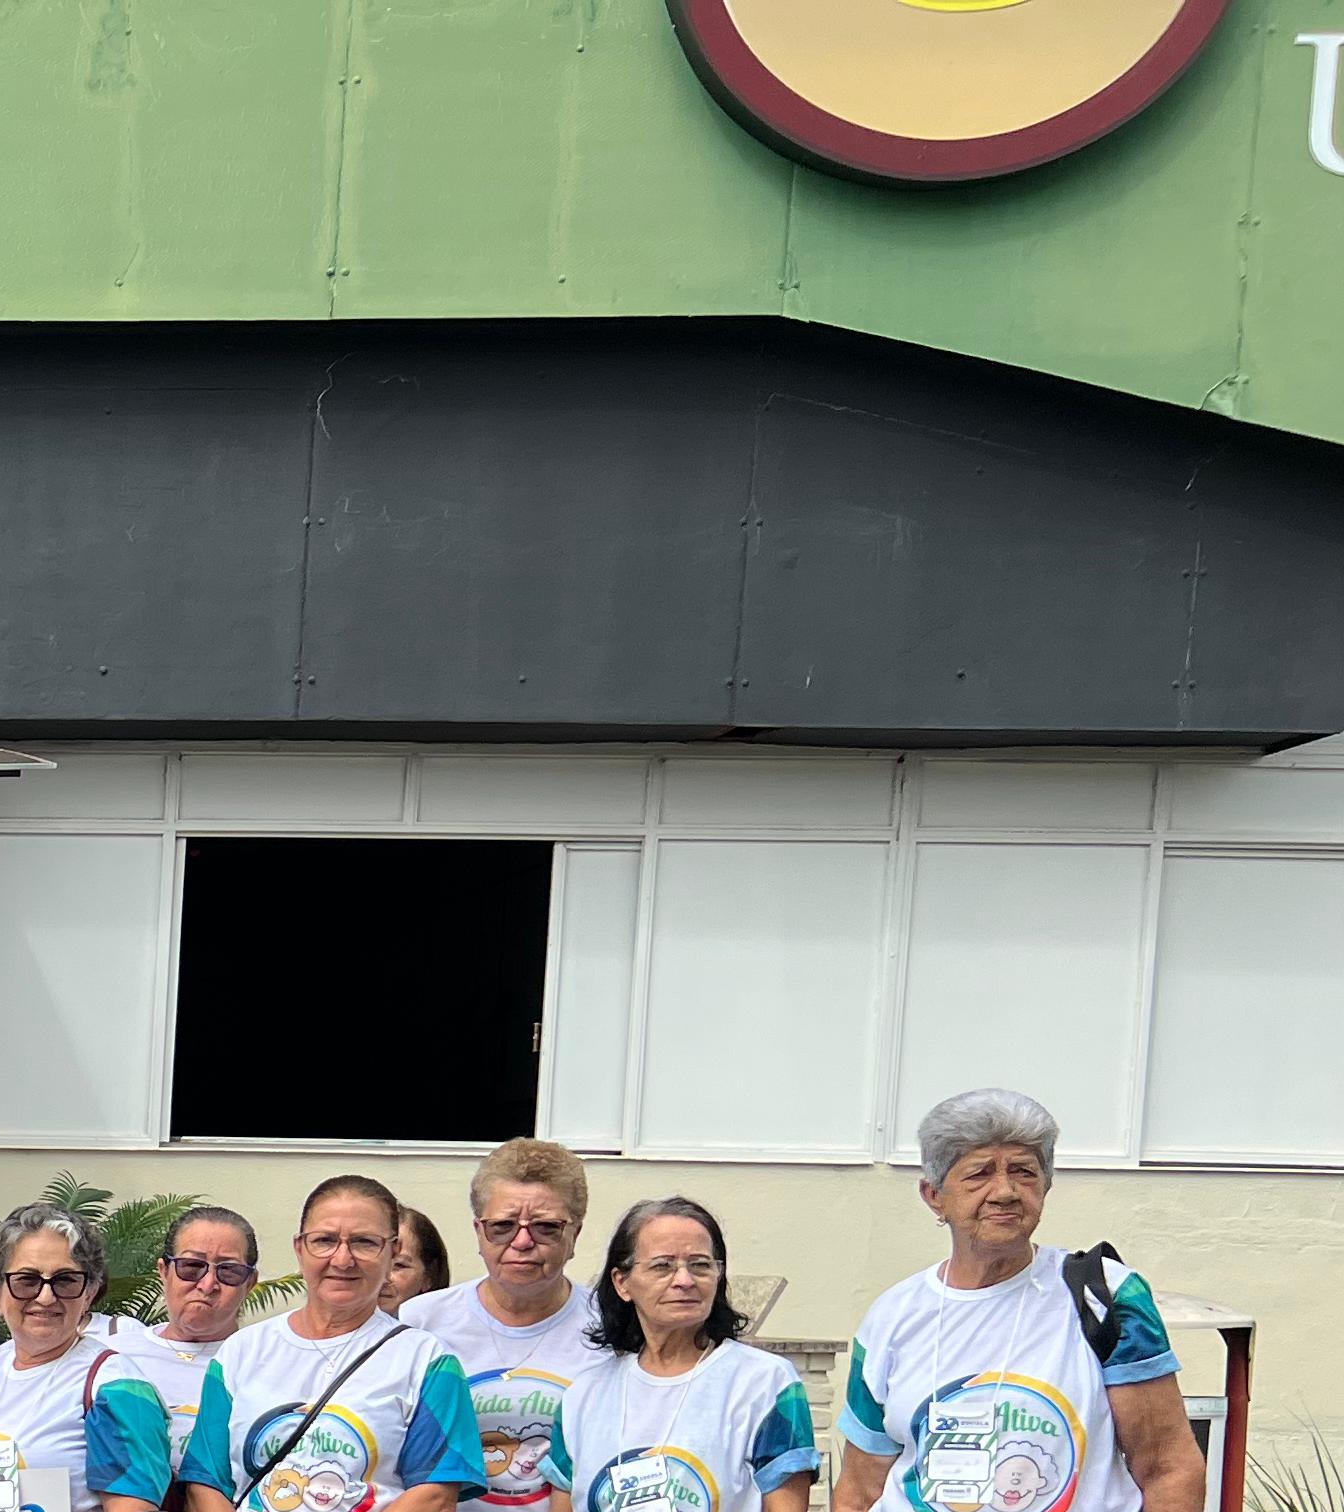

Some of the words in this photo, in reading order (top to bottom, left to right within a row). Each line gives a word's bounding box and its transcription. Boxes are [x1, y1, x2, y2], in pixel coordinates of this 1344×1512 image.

[520, 1390, 555, 1417] Ati
[996, 1401, 1061, 1437] Ativa
[936, 1417, 959, 1431] 20
[263, 1436, 307, 1461] Via
[308, 1426, 359, 1459] Ativa
